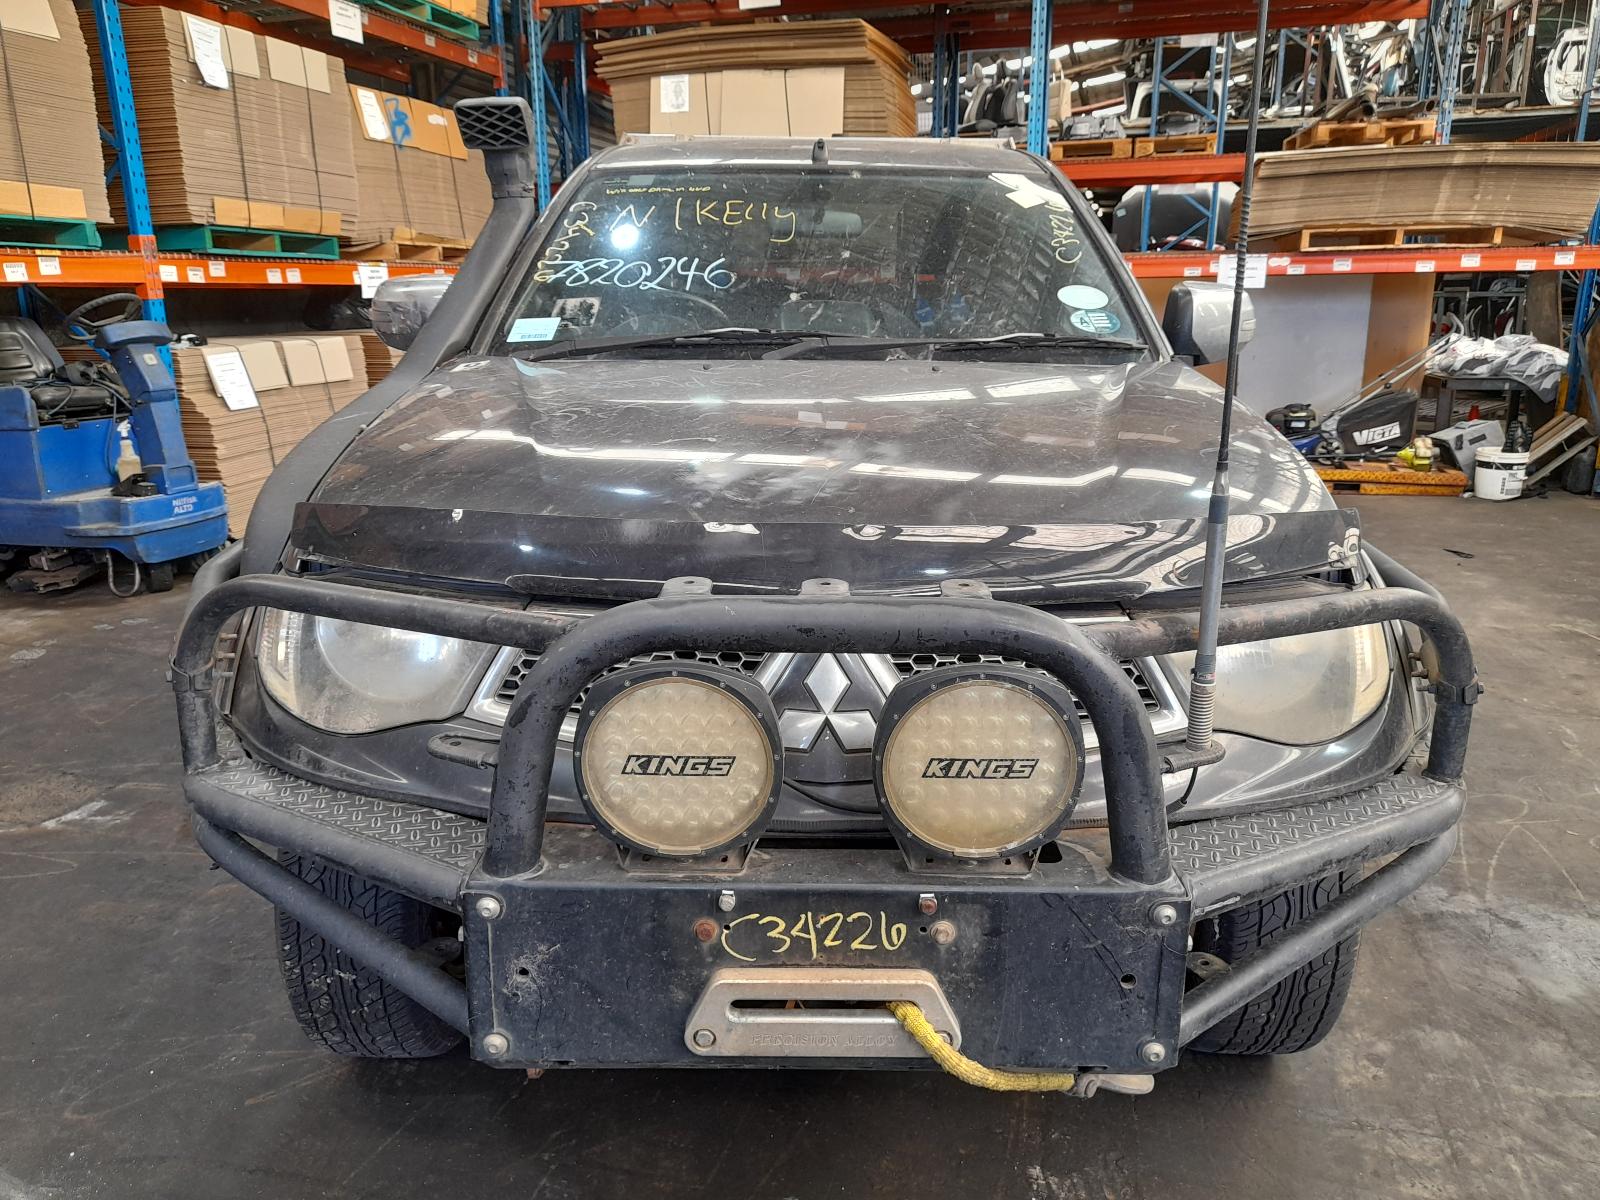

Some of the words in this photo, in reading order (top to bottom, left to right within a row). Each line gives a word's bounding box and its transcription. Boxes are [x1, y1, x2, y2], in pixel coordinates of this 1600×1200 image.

[1352, 421, 1400, 446] VICTA
[621, 755, 736, 776] KINGS
[922, 758, 1039, 779] KINGS
[721, 911, 907, 961] C34226
